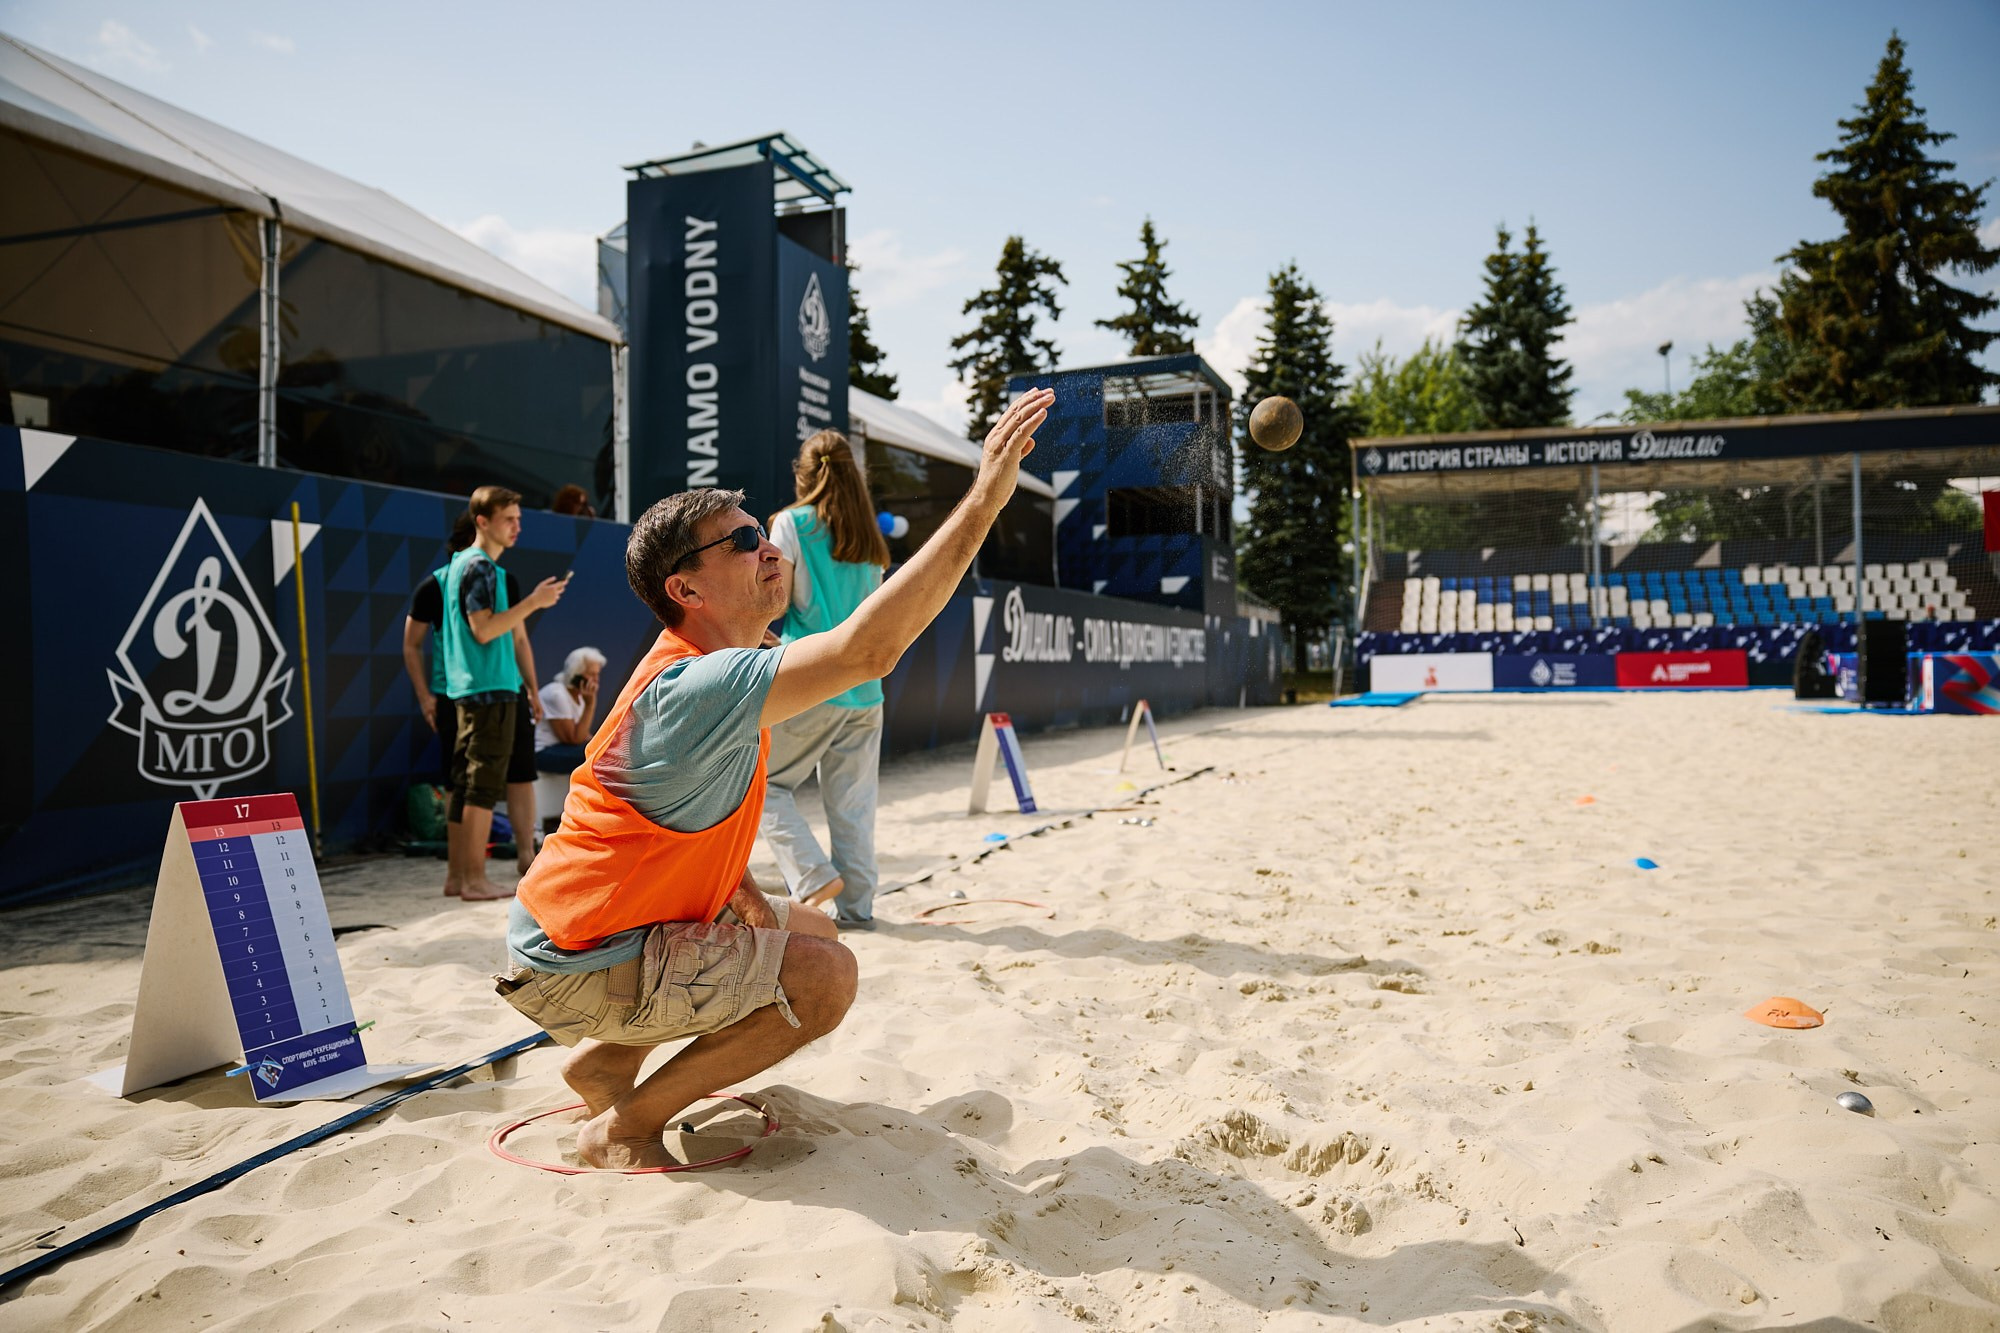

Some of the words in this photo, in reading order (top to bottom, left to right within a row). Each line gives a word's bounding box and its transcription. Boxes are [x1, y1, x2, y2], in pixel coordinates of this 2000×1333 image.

[684, 214, 719, 353] VODNY
[687, 362, 719, 492] NAMO
[1387, 449, 1461, 472] ИСТОРИЯ
[1463, 445, 1529, 468] СТРАНЫ
[1545, 440, 1622, 464] ИСТОРИЯ
[154, 727, 256, 773] МГО
[234, 804, 250, 818] 17
[214, 828, 225, 838] 13
[271, 822, 281, 830] 13
[218, 842, 230, 853] 12
[275, 835, 286, 846] 12
[223, 859, 234, 870] 11
[280, 851, 290, 862] 11
[228, 876, 239, 886] 10
[285, 867, 295, 878] 10
[234, 893, 240, 902] 9
[290, 884, 296, 893] 9
[238, 910, 246, 920] 8
[296, 900, 302, 910] 8
[242, 927, 248, 937] 7
[299, 916, 306, 926] 7
[248, 944, 254, 954] 6
[304, 932, 310, 941] 6
[252, 961, 258, 971] 5
[308, 949, 314, 958] 5
[256, 978, 262, 988] 4
[312, 966, 318, 974] 4
[260, 996, 267, 1006] 3
[317, 982, 322, 991] 3
[265, 1013, 272, 1022] 2
[321, 998, 327, 1008] 2
[303, 1058, 317, 1068] КЛУБ
